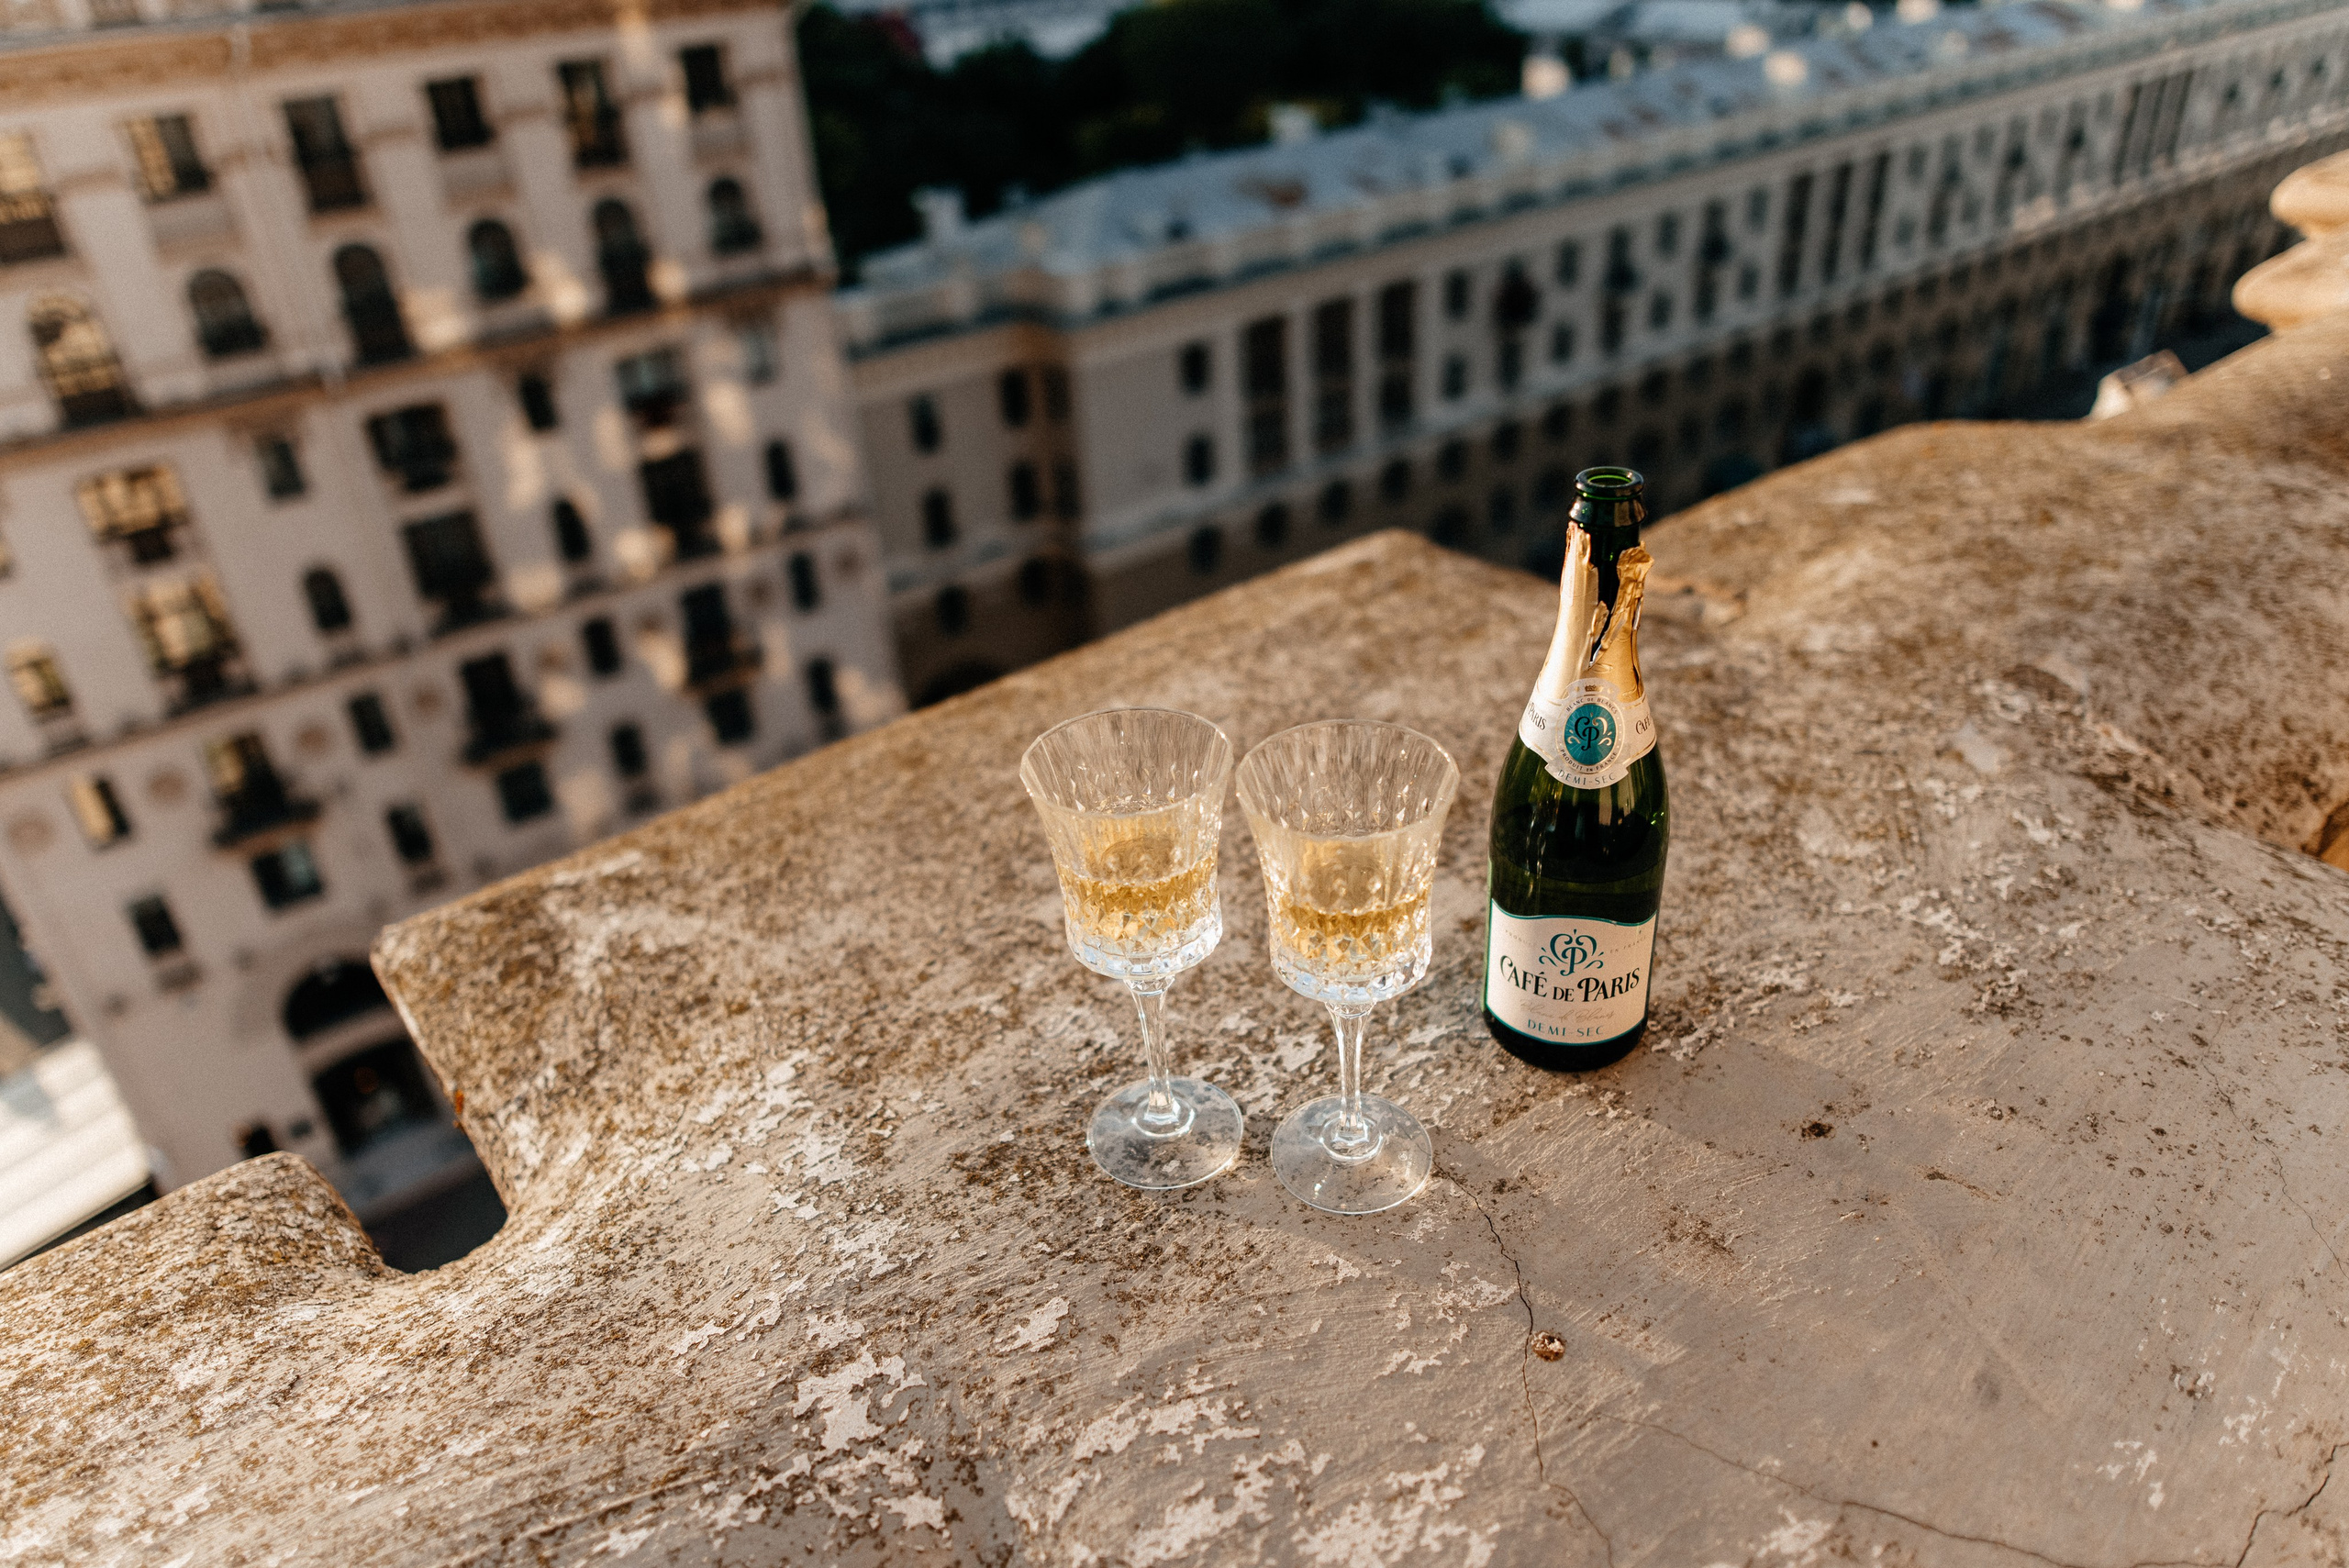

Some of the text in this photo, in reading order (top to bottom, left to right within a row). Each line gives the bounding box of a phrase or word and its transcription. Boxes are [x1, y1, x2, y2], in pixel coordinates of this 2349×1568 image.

[1528, 702, 1547, 730] PARIS
[1565, 698, 1584, 712] BLANC
[1597, 698, 1618, 715] BLANCS
[1560, 749, 1583, 771] PRODUIT
[1596, 751, 1617, 771] FRANCE
[1558, 769, 1616, 785] DEMI-SEC
[1499, 954, 1640, 1002] CAFÉ DE PARIS
[1527, 1018, 1605, 1037] DEMI-SEC
